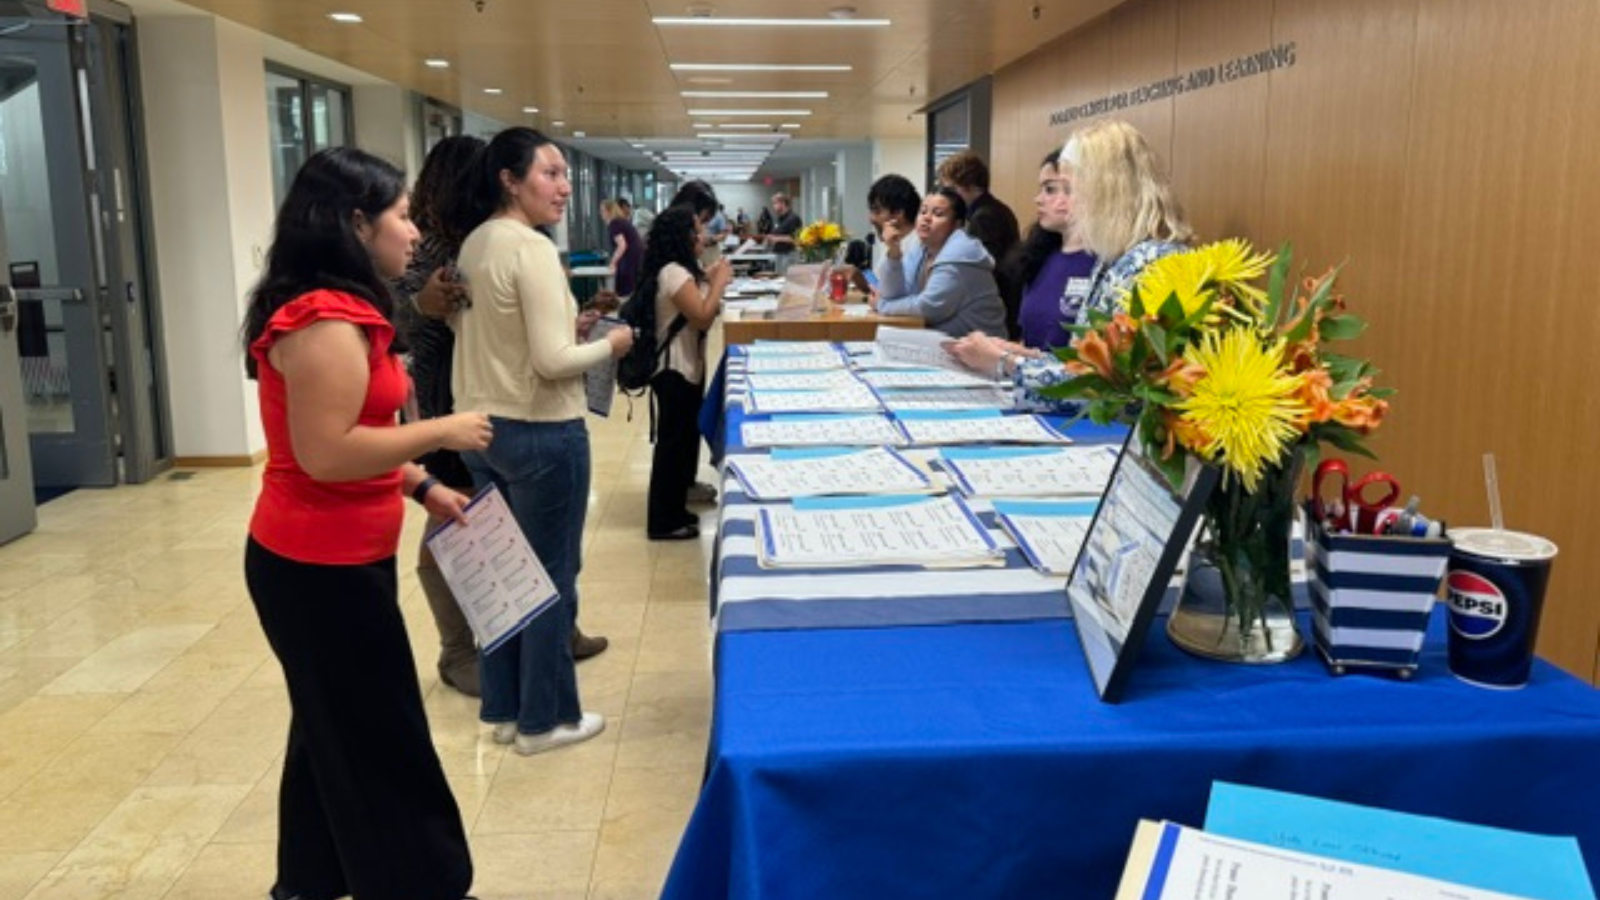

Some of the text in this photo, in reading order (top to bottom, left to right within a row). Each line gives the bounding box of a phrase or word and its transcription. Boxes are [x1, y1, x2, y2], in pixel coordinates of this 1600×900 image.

[1184, 67, 1215, 91] AND
[1219, 41, 1296, 84] LEARNING
[1450, 593, 1502, 616] EPSI
